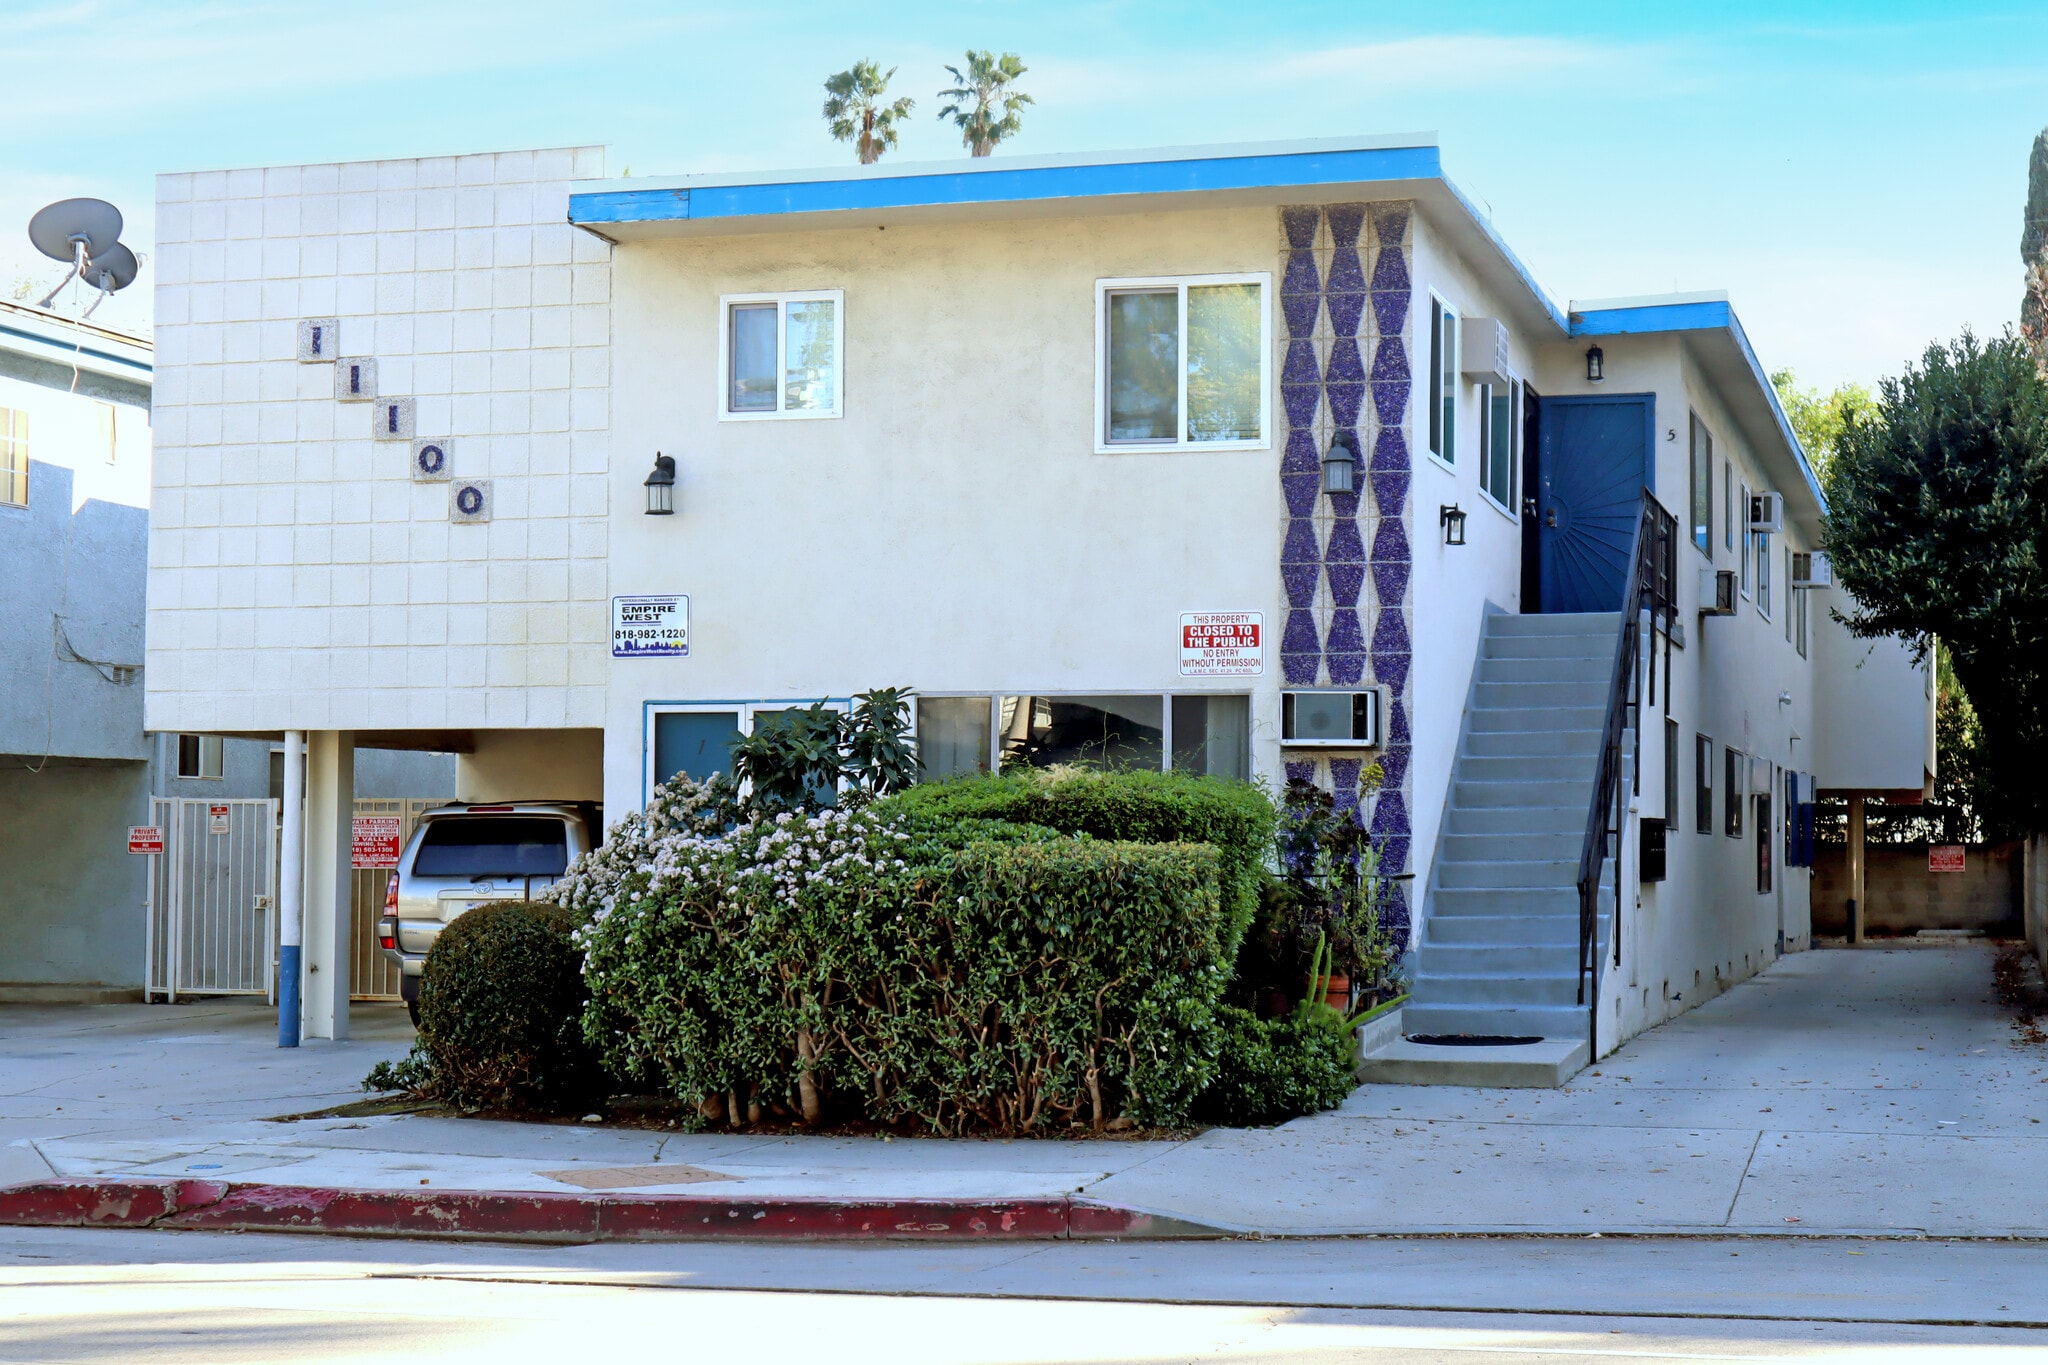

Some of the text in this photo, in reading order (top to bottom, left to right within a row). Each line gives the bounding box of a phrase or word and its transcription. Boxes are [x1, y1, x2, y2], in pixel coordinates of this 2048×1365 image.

[1667, 429, 1675, 441] 5
[622, 605, 676, 613] EMPIRE
[622, 613, 662, 621] WEST
[1193, 615, 1250, 624] THIS PROPERTY
[615, 629, 686, 639] 818-982-1220
[1190, 625, 1253, 637] CLOSED TO
[1187, 636, 1255, 648] THE PUBLIC
[1203, 649, 1240, 658] NO ENTRY
[1182, 658, 1261, 668] WITHOUT PERMISSION
